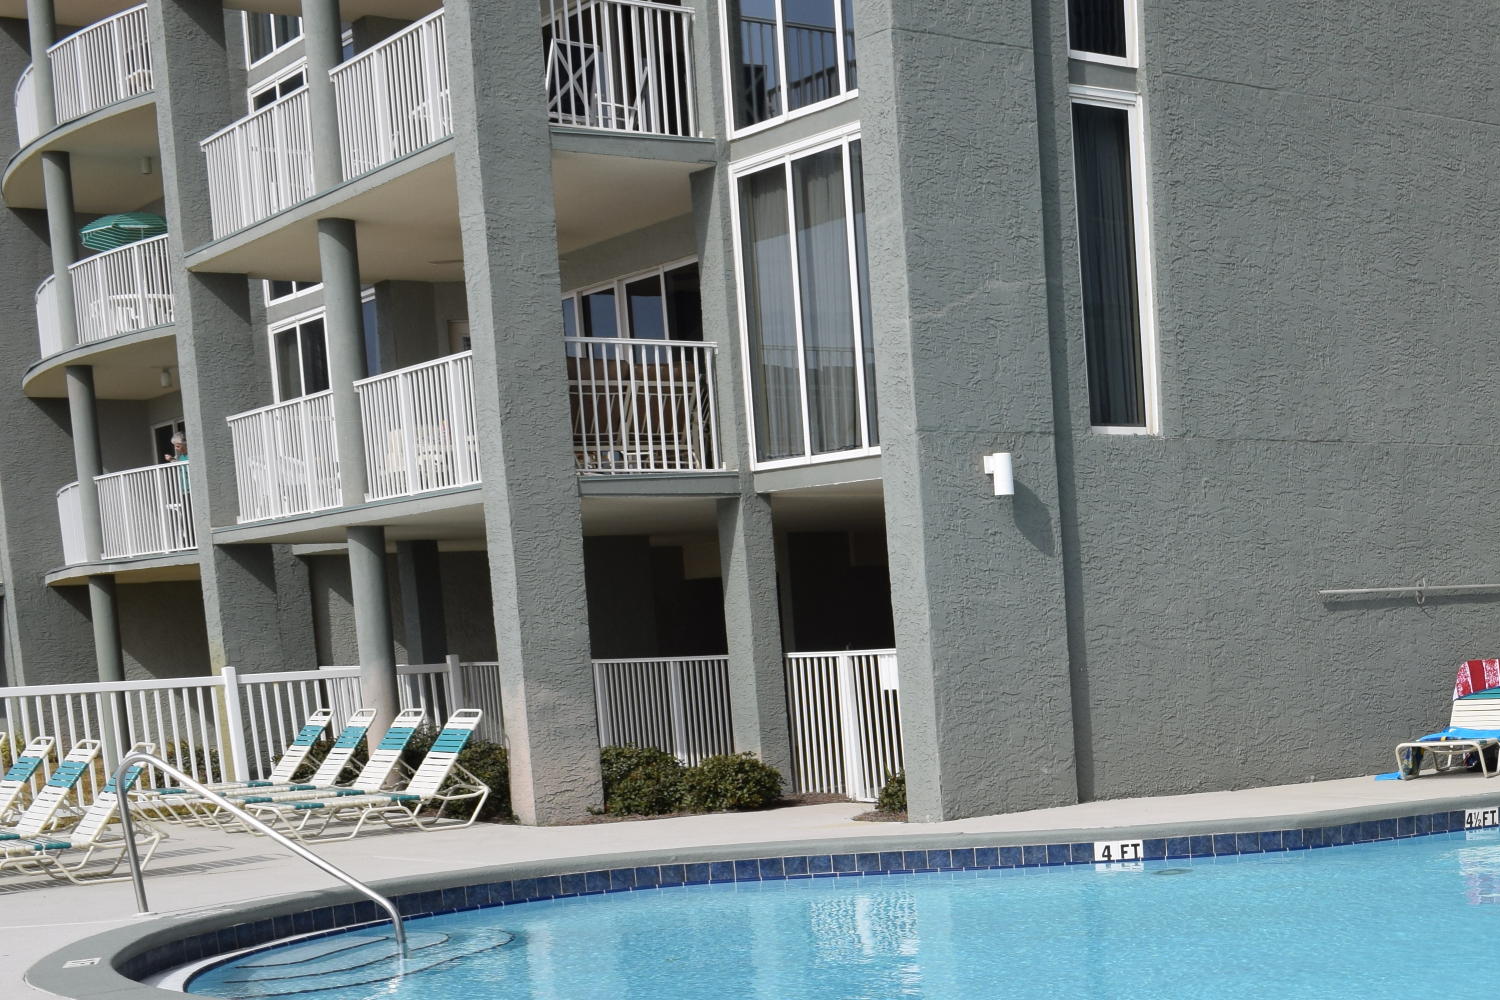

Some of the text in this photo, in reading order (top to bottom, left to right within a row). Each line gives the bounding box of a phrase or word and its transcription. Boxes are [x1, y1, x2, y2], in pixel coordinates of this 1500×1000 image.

[1483, 810, 1496, 826] FT
[1101, 843, 1140, 860] 4 FT
